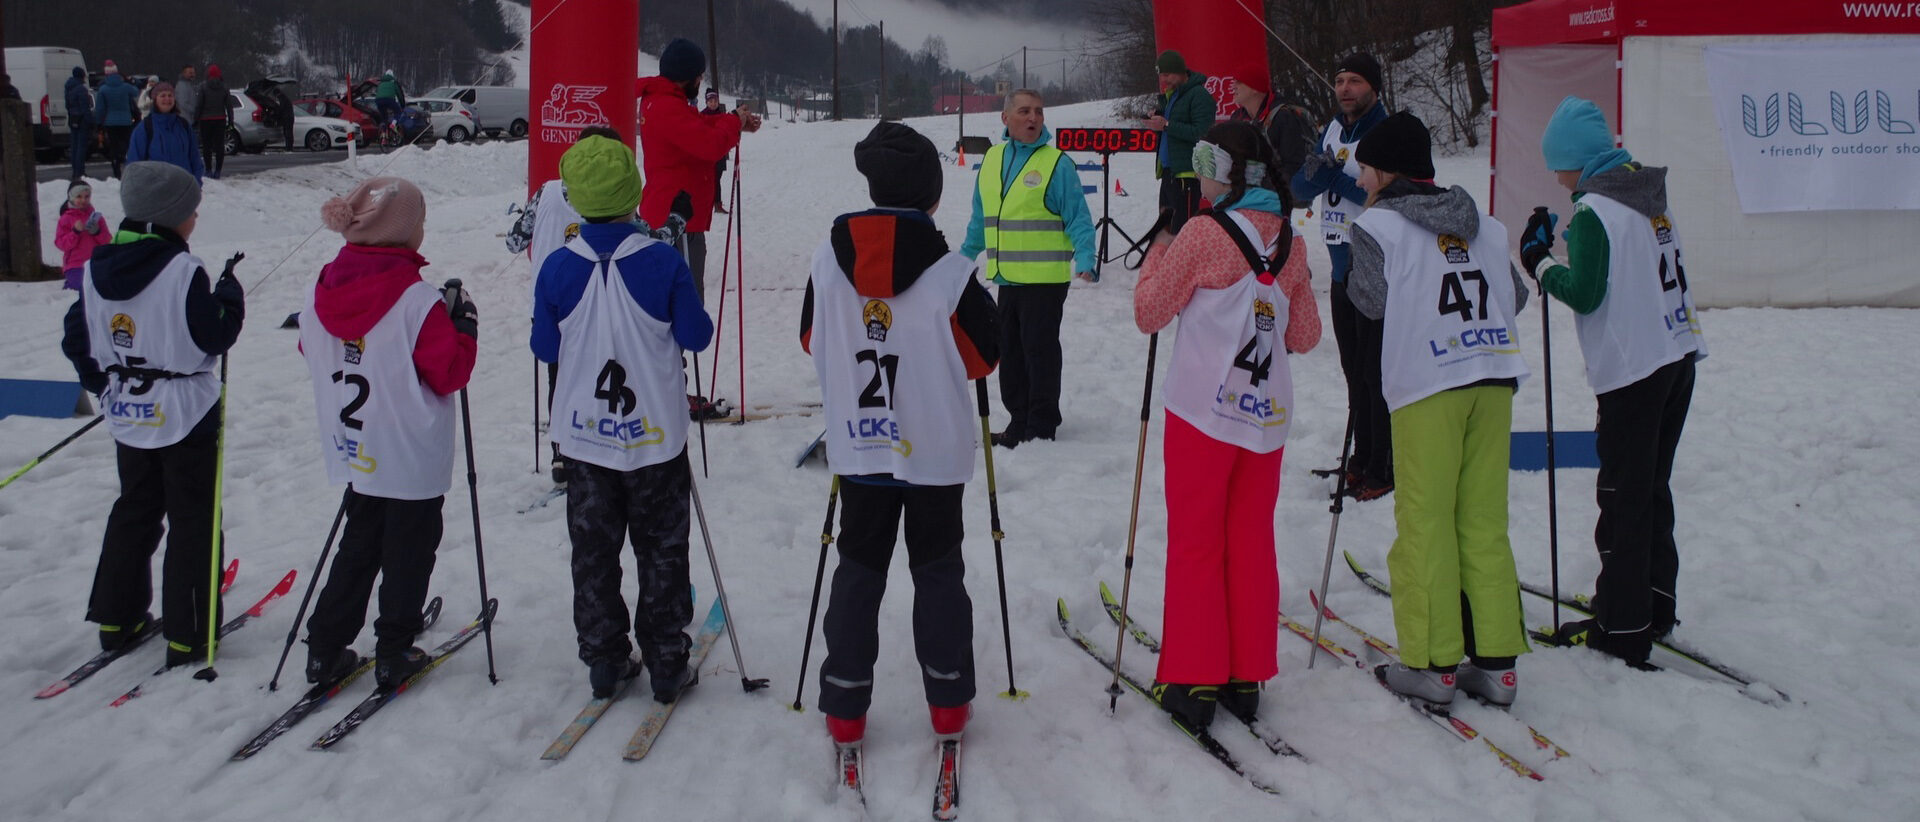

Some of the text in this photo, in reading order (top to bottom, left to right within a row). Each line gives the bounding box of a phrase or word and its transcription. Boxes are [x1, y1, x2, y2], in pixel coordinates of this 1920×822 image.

[1568, 1, 1616, 26] www.redcross.sk
[541, 128, 581, 143] GENE
[1741, 90, 1920, 138] ULUL
[1770, 144, 1824, 158] friendly
[1831, 143, 1889, 155] outdoor
[1438, 269, 1489, 322] 47
[118, 353, 155, 396] 5
[855, 349, 899, 410] 21
